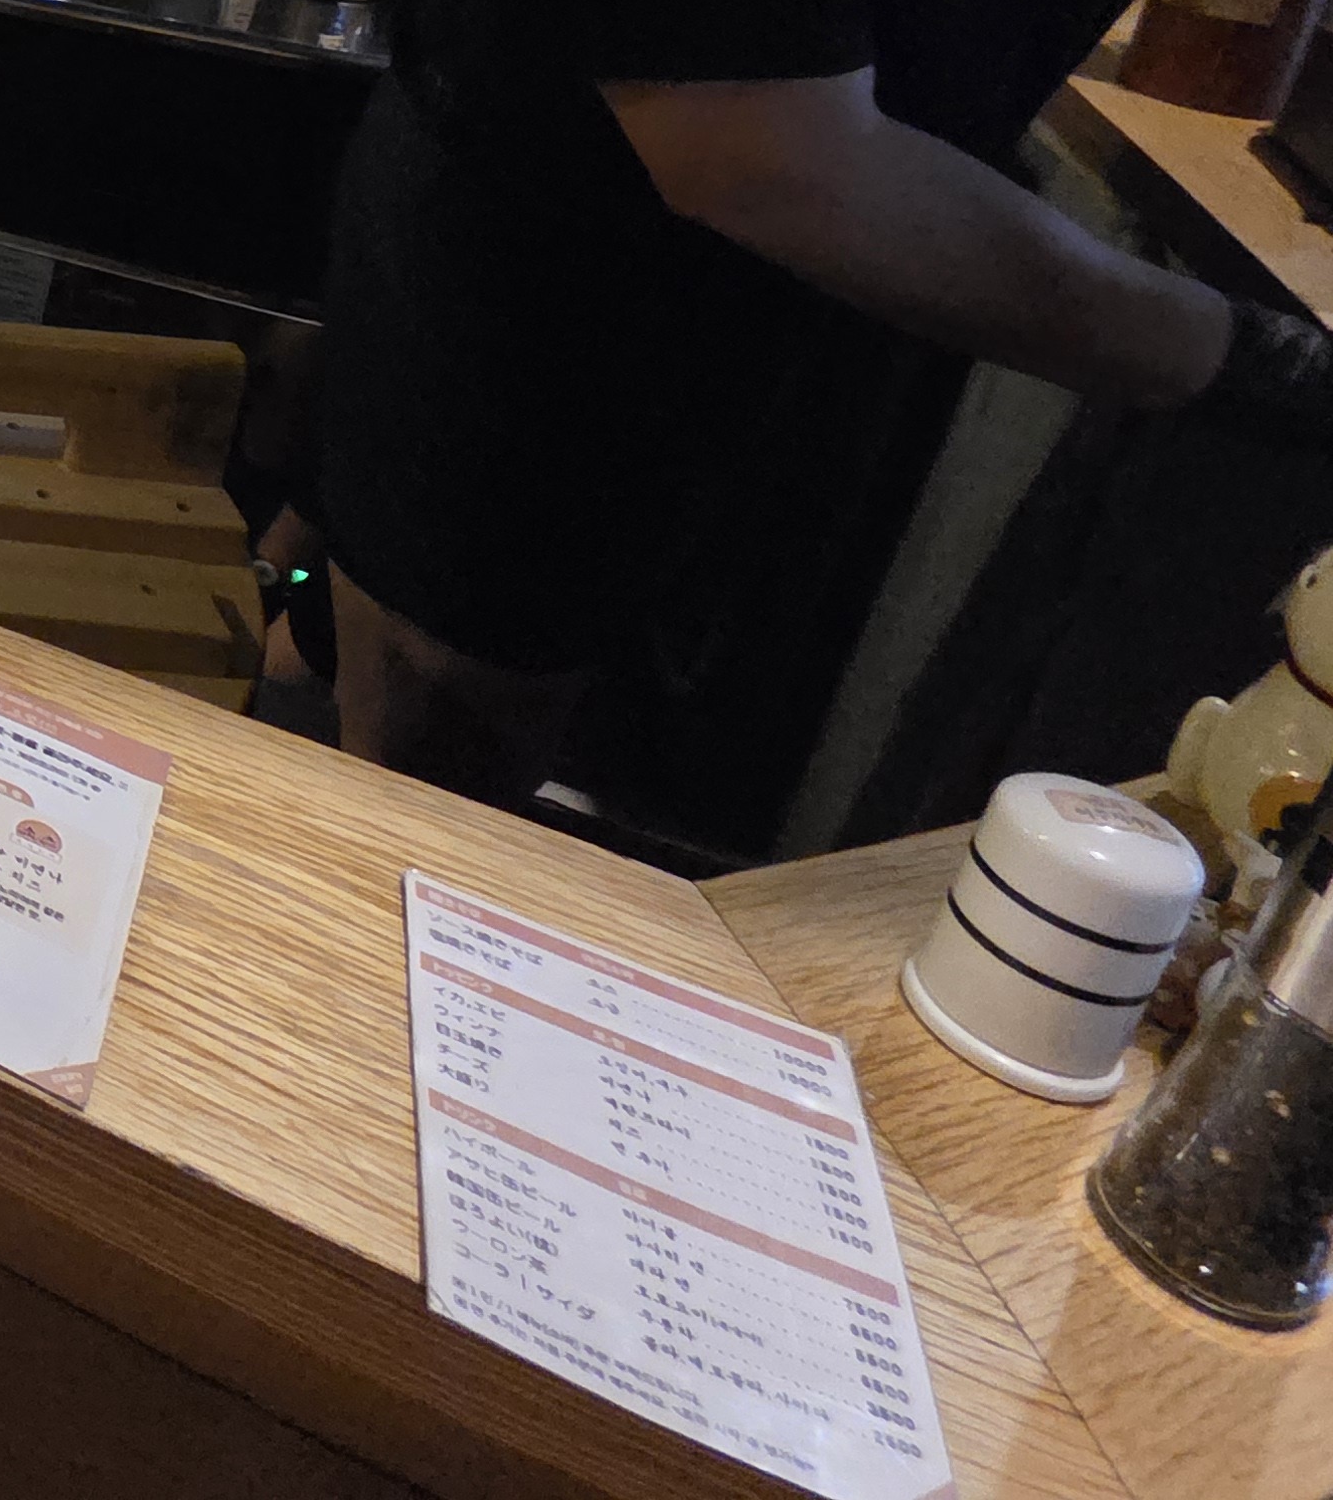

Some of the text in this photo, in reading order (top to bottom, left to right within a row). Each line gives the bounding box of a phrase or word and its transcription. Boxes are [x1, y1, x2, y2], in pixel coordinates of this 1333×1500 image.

[14, 855, 62, 884] 비엔나
[428, 911, 542, 965] ソース焼きそば
[435, 1021, 502, 1059] 目玉焼き
[437, 1042, 489, 1074] チーズ
[772, 1048, 827, 1076] 10000
[438, 1063, 489, 1092] 大盛り
[777, 1068, 832, 1097] 10000
[443, 1125, 536, 1175] ハイボール
[804, 1134, 849, 1160] 1500
[447, 1146, 577, 1217] アサヒ缶ビール
[809, 1156, 855, 1183] 1500
[817, 1180, 862, 1206] 1500
[822, 1202, 867, 1230] 1500
[451, 1218, 548, 1276] ウーロン茶
[827, 1226, 873, 1254] 1500
[842, 1297, 891, 1325] 7500
[849, 1322, 897, 1351] 6500
[854, 1348, 903, 1377] 5500
[860, 1374, 909, 1404] 6500
